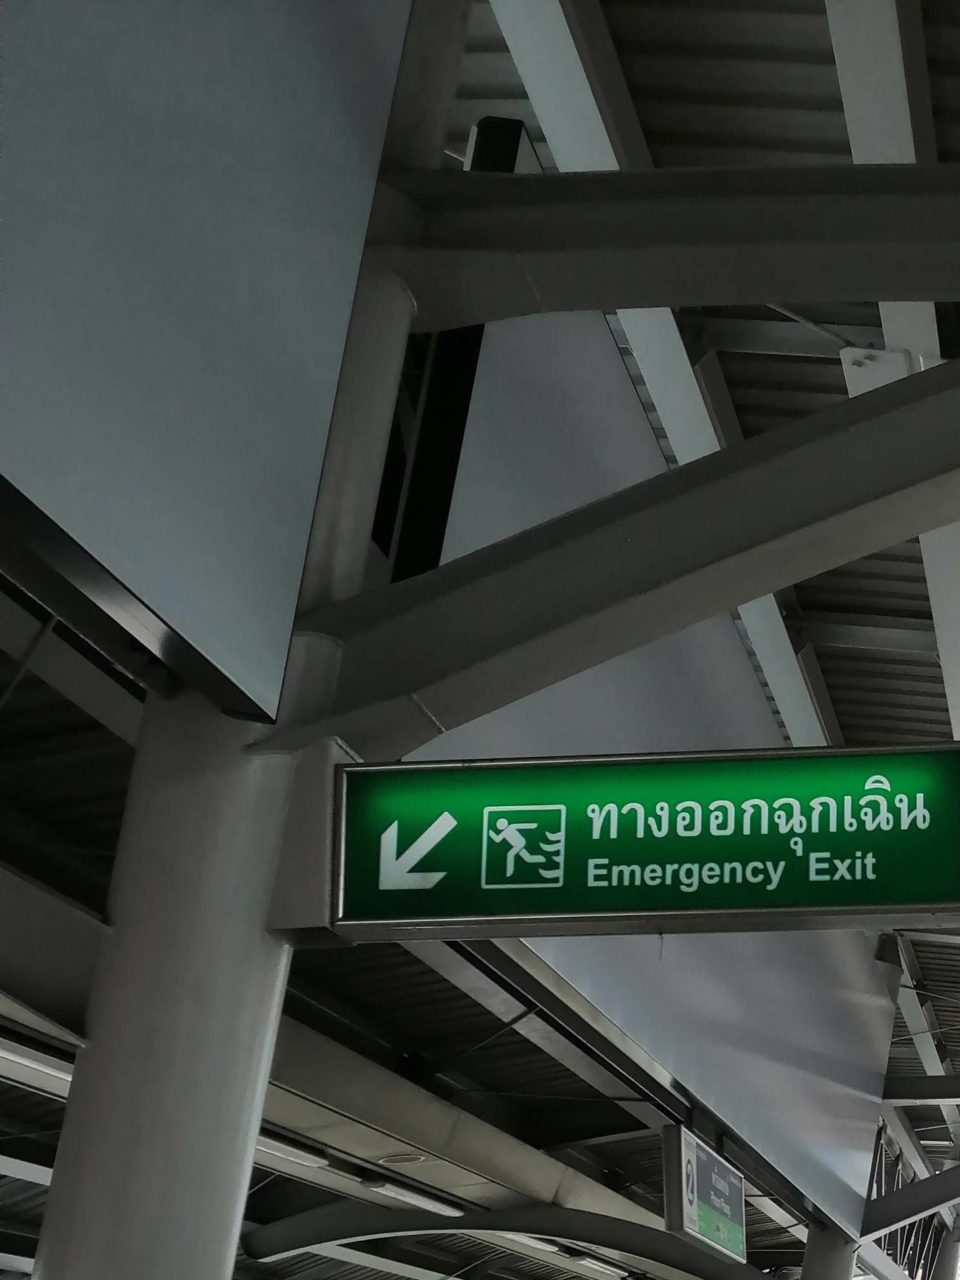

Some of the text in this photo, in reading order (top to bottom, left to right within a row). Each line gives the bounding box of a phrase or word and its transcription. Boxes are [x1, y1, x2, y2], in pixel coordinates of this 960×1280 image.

[587, 775, 931, 857] ทางออกฉุกเฉิน
[587, 851, 877, 893] Emergency Exit
[686, 1163, 695, 1200] 2
